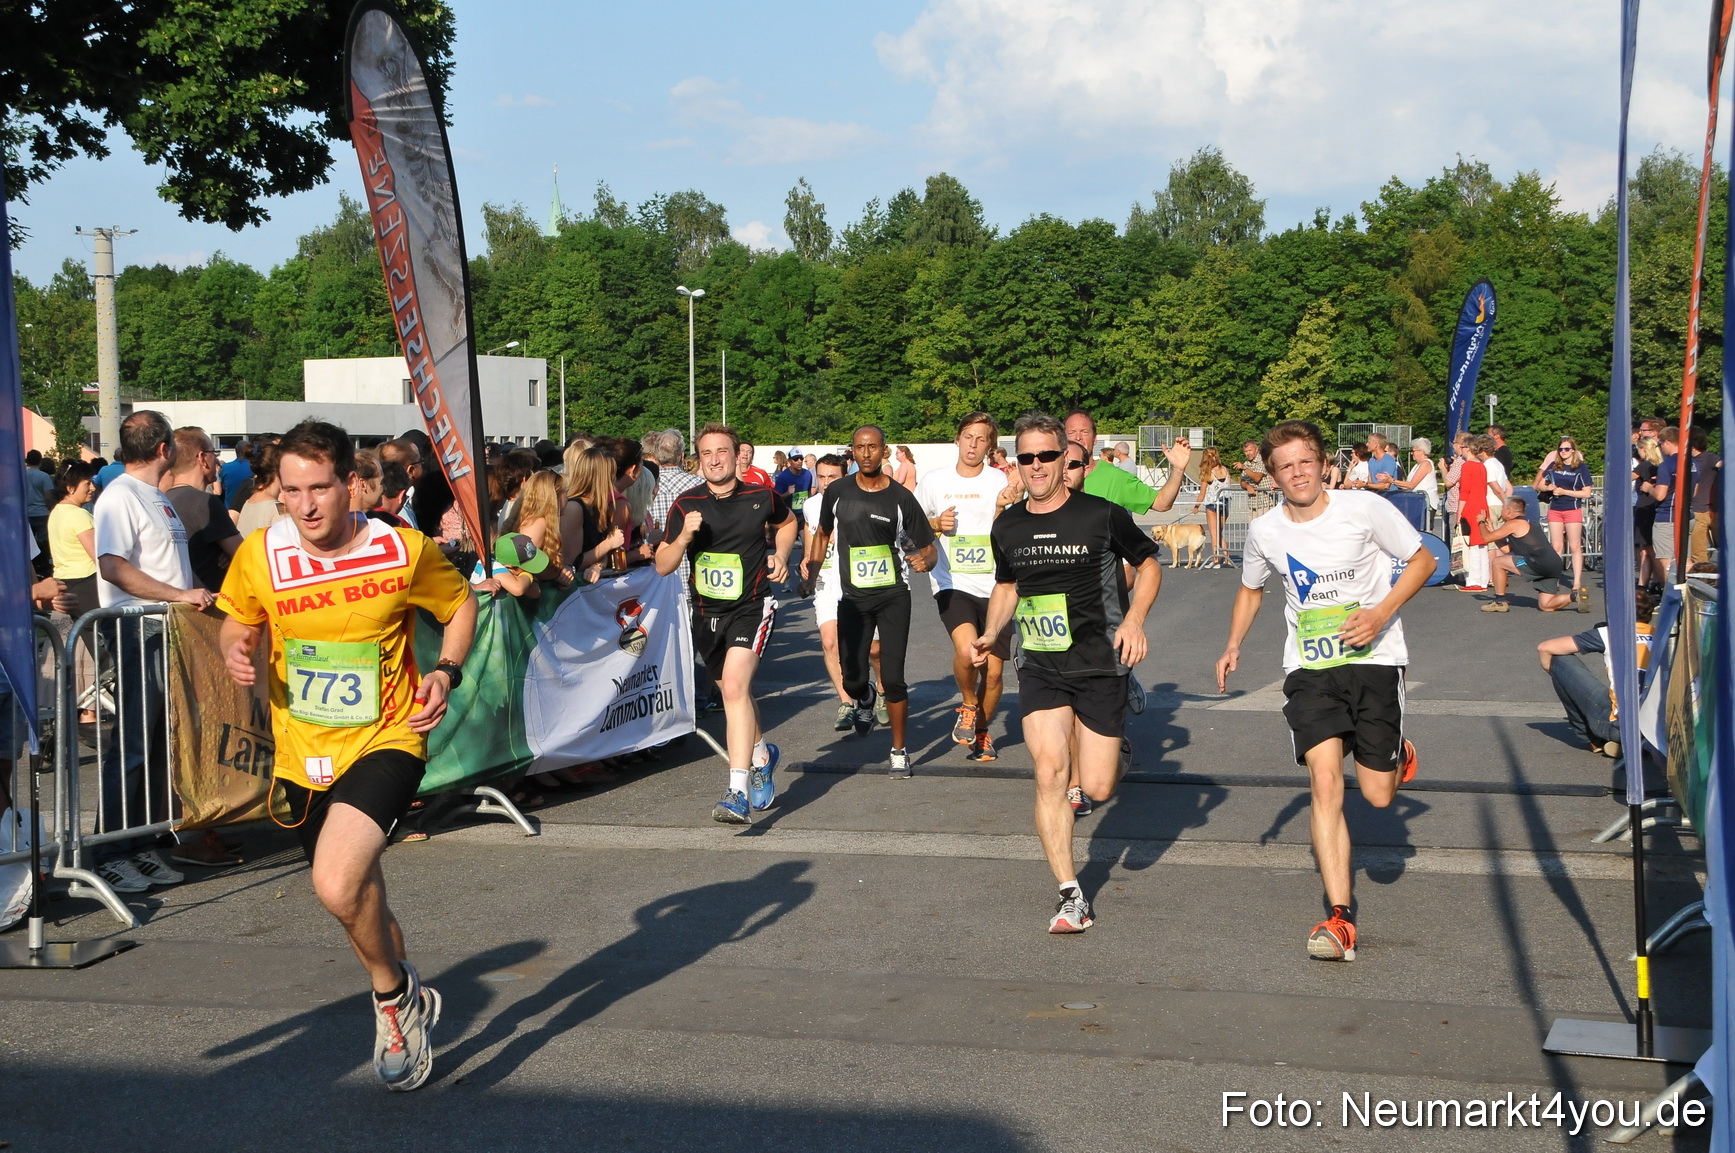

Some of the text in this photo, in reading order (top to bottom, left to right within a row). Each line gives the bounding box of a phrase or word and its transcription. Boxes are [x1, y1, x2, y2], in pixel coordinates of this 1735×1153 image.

[955, 548, 986, 563] 542
[1013, 545, 1089, 558] SPORTNANKA
[701, 567, 734, 588] 103
[856, 559, 889, 578] 974
[1294, 569, 1355, 587] Running
[276, 576, 409, 617] MAX BÖGL
[1304, 589, 1338, 602] Team
[1020, 615, 1067, 638] 1106
[1303, 632, 1366, 662] 507
[296, 668, 363, 706] 773
[611, 664, 658, 698] Neumarkter
[600, 683, 674, 733] Lammsbräu
